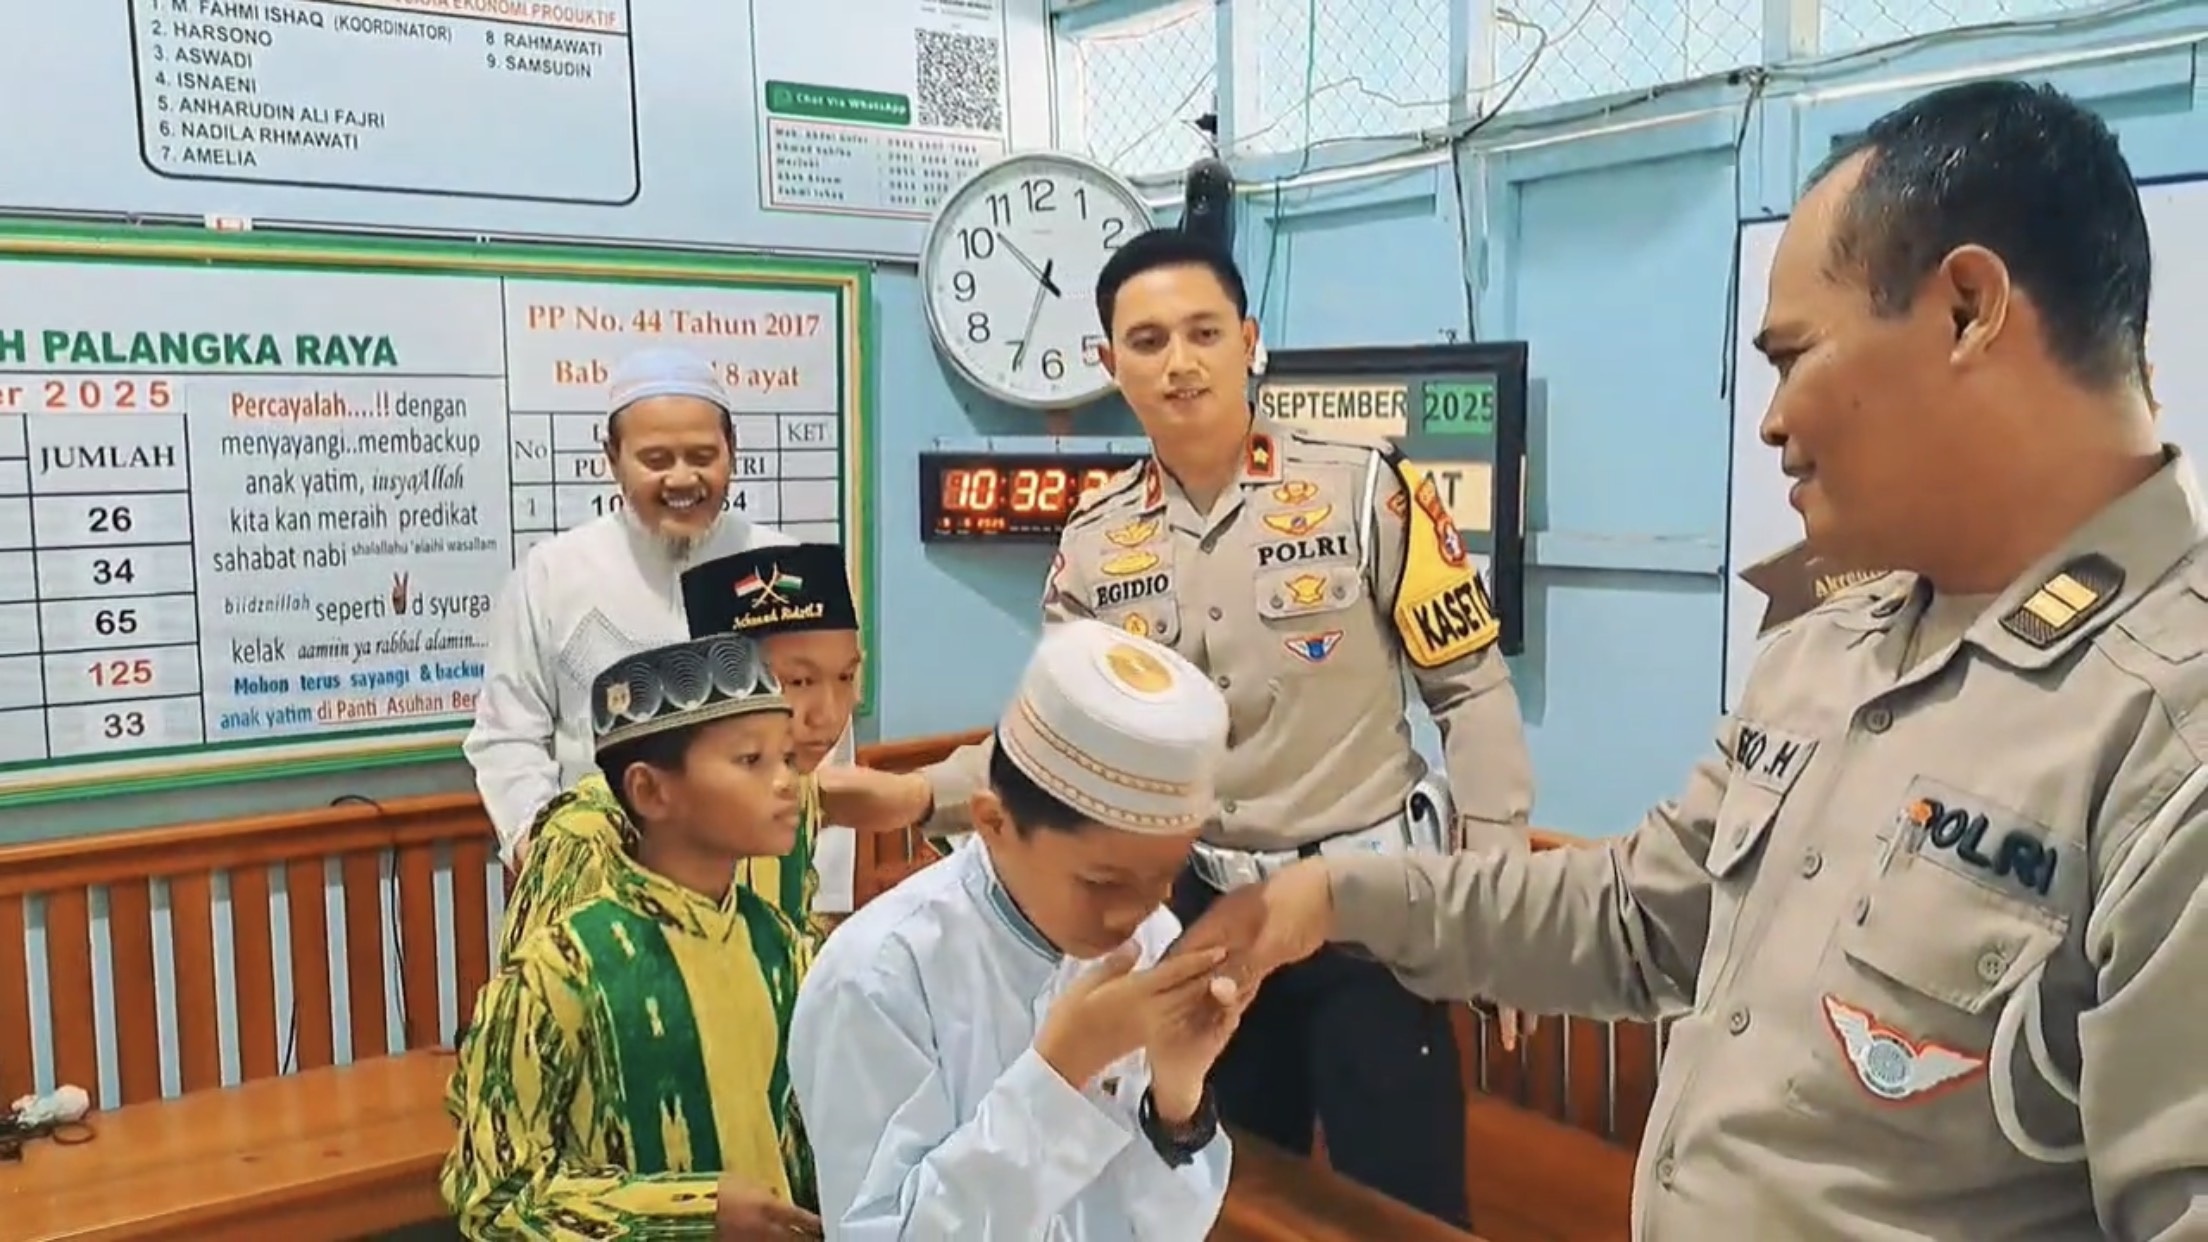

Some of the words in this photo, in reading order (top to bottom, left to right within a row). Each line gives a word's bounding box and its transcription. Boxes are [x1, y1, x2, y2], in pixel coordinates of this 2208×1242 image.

[200, 1, 259, 20] FAHMI
[265, 6, 325, 28] ISHAQ
[334, 15, 451, 43] (KOORDINATOR)
[531, 5, 617, 28] PRODUKTIF
[151, 20, 167, 37] 2.
[174, 22, 273, 47] HARSONO
[504, 32, 602, 56] RAHMAWATI
[154, 45, 169, 62] 3.
[175, 47, 252, 69] ASWADI
[487, 53, 500, 69] 9.
[505, 55, 592, 78] SAMSUDIN
[156, 71, 171, 86] 4.
[177, 72, 257, 94] ISNAENI
[158, 95, 173, 111] 5.
[179, 97, 294, 121] ANHARUDIN
[300, 107, 328, 123] ALI
[335, 109, 385, 128] FAJRI
[796, 92, 823, 106] Chat
[848, 98, 907, 115] WhatsApp
[159, 120, 175, 137] 6.
[181, 122, 254, 142] NADILA
[260, 127, 358, 150] RHMAWATI
[161, 146, 177, 162] 7.
[182, 147, 257, 167] AMELIA
[986, 193, 1011, 227] 11
[1020, 179, 1056, 213] 12
[1074, 187, 1088, 220] 1
[958, 227, 995, 260] 10
[1102, 217, 1125, 249] 2
[953, 270, 977, 302] 9
[528, 305, 565, 330] PP
[576, 305, 624, 333] No.
[631, 312, 662, 334] 44
[671, 309, 756, 335] Tahun
[765, 312, 820, 337] 2017
[967, 312, 991, 344] 8
[43, 329, 281, 365] PALANGKA
[295, 333, 398, 366] RAYA
[1004, 340, 1025, 372] 7
[1081, 335, 1103, 367] 5
[555, 360, 608, 385] Bab
[748, 363, 799, 395] ayat
[1041, 349, 1065, 380] 6
[396, 394, 467, 423] dengan
[1261, 389, 1408, 419] SEPTEMBER
[1424, 391, 1494, 422] 2025
[788, 423, 826, 443] KET
[41, 446, 176, 475] JUMLAH
[515, 440, 548, 459] No
[246, 468, 295, 496] anak
[302, 467, 365, 498] yatim,
[88, 506, 132, 533] 26
[231, 507, 269, 533] kita
[275, 506, 312, 531] kan
[318, 503, 388, 530] meraih
[400, 501, 478, 533] predikat
[213, 544, 297, 573] sahabat
[303, 541, 347, 569] nabi
[447, 537, 498, 552] wasallam
[1258, 535, 1349, 566] POLRI
[93, 558, 135, 586] 34
[1095, 572, 1169, 609] EGIDIO
[95, 609, 138, 636] 65
[316, 594, 386, 625] seperti
[430, 594, 490, 619] syurga
[232, 637, 285, 665] kelak
[353, 640, 371, 664] ya
[376, 629, 421, 655] rabbal
[88, 660, 153, 687] 125
[234, 674, 289, 696] Mohon
[300, 672, 341, 692] terus
[350, 668, 410, 691] sayangi
[420, 665, 431, 682] &
[104, 712, 145, 739] 33
[220, 706, 259, 730] anak
[266, 704, 312, 728] yatim
[318, 700, 332, 720] di
[337, 697, 377, 718] Panti
[387, 692, 443, 715] Asuhan
